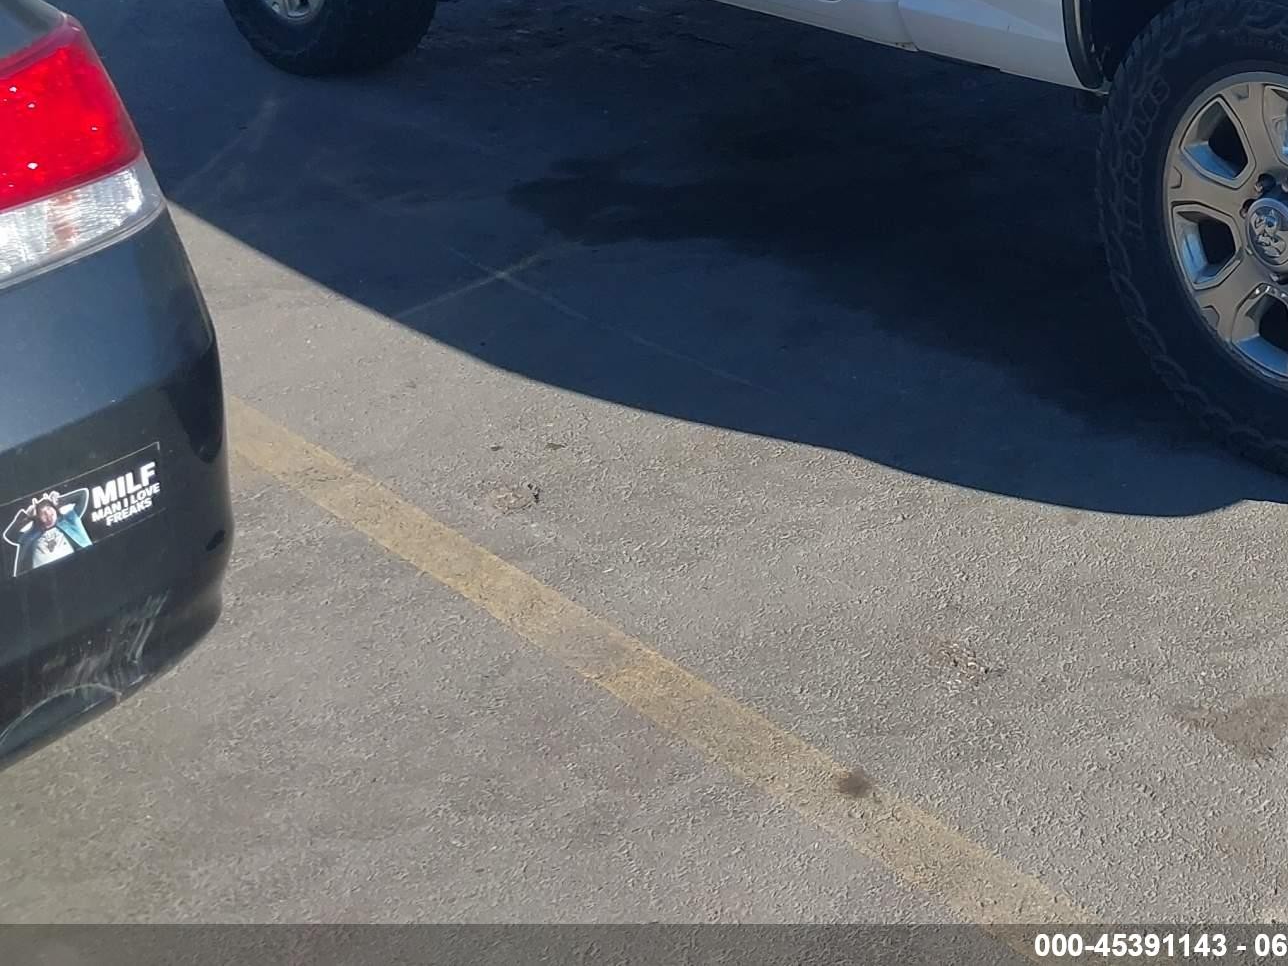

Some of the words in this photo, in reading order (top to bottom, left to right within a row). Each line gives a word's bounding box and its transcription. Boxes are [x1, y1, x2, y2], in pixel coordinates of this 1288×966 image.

[91, 501, 122, 523] MAN
[123, 497, 129, 508] I
[129, 482, 160, 505] LOVE
[92, 461, 156, 510] MILF
[105, 497, 152, 527] FREAKS
